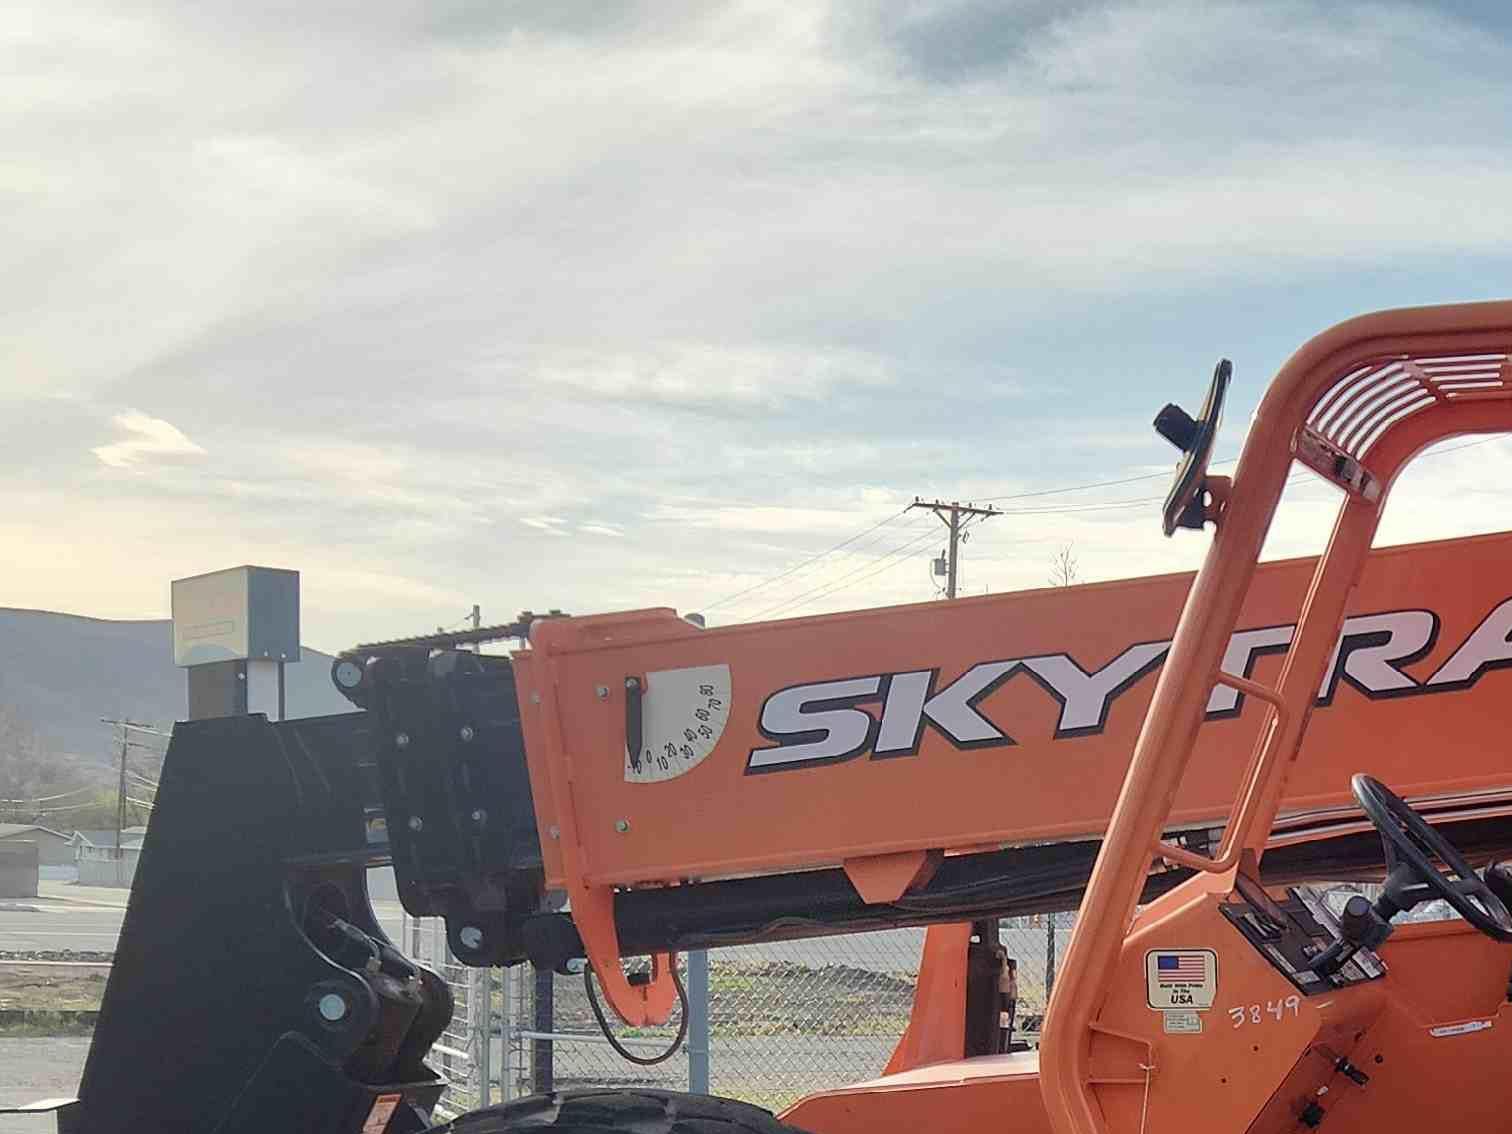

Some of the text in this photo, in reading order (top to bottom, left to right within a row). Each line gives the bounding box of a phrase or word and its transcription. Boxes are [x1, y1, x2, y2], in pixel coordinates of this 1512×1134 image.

[646, 750, 652, 763] 0
[664, 742, 677, 757] 20
[657, 756, 668, 770] 10
[1171, 994, 1194, 1004] USA
[1229, 995, 1301, 1028] 3849
